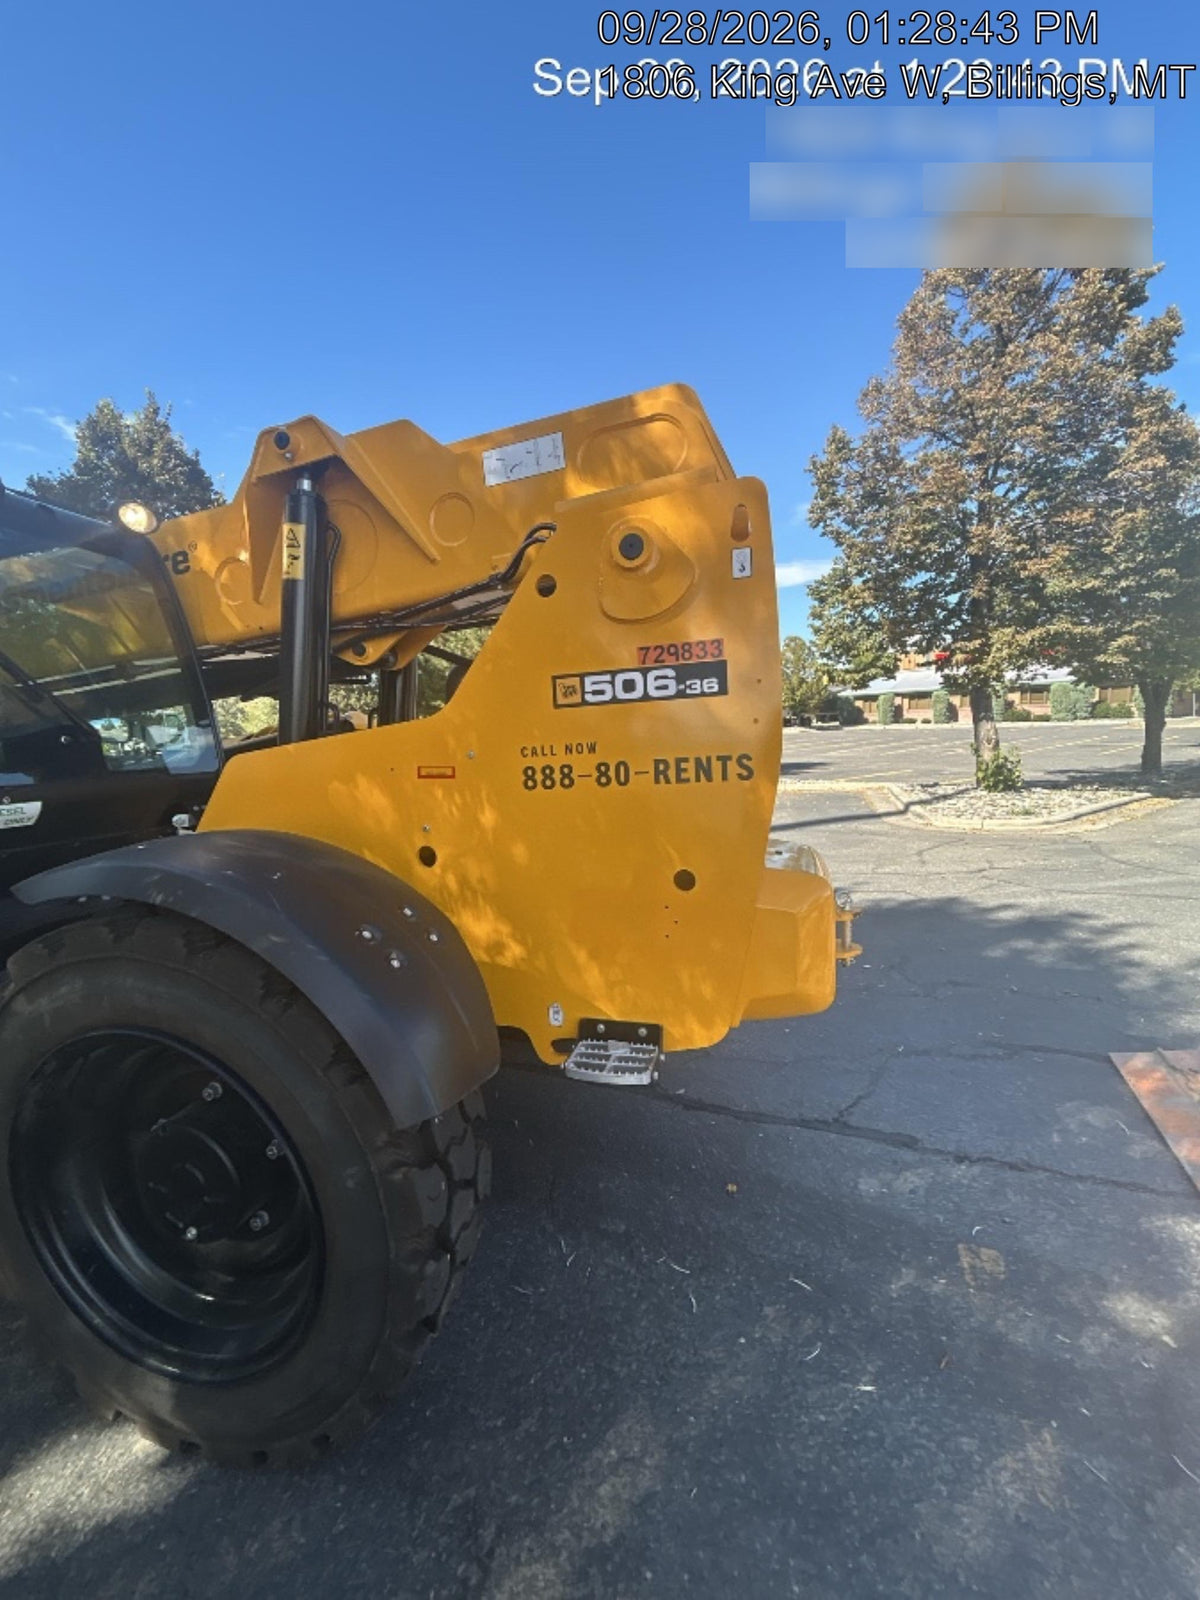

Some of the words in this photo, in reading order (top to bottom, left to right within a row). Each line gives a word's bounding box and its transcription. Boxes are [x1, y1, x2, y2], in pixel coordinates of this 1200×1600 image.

[637, 638, 724, 665] 729833
[520, 744, 557, 758] CALL
[565, 741, 597, 756] NOW
[522, 753, 755, 792] 888-80-RENTS
